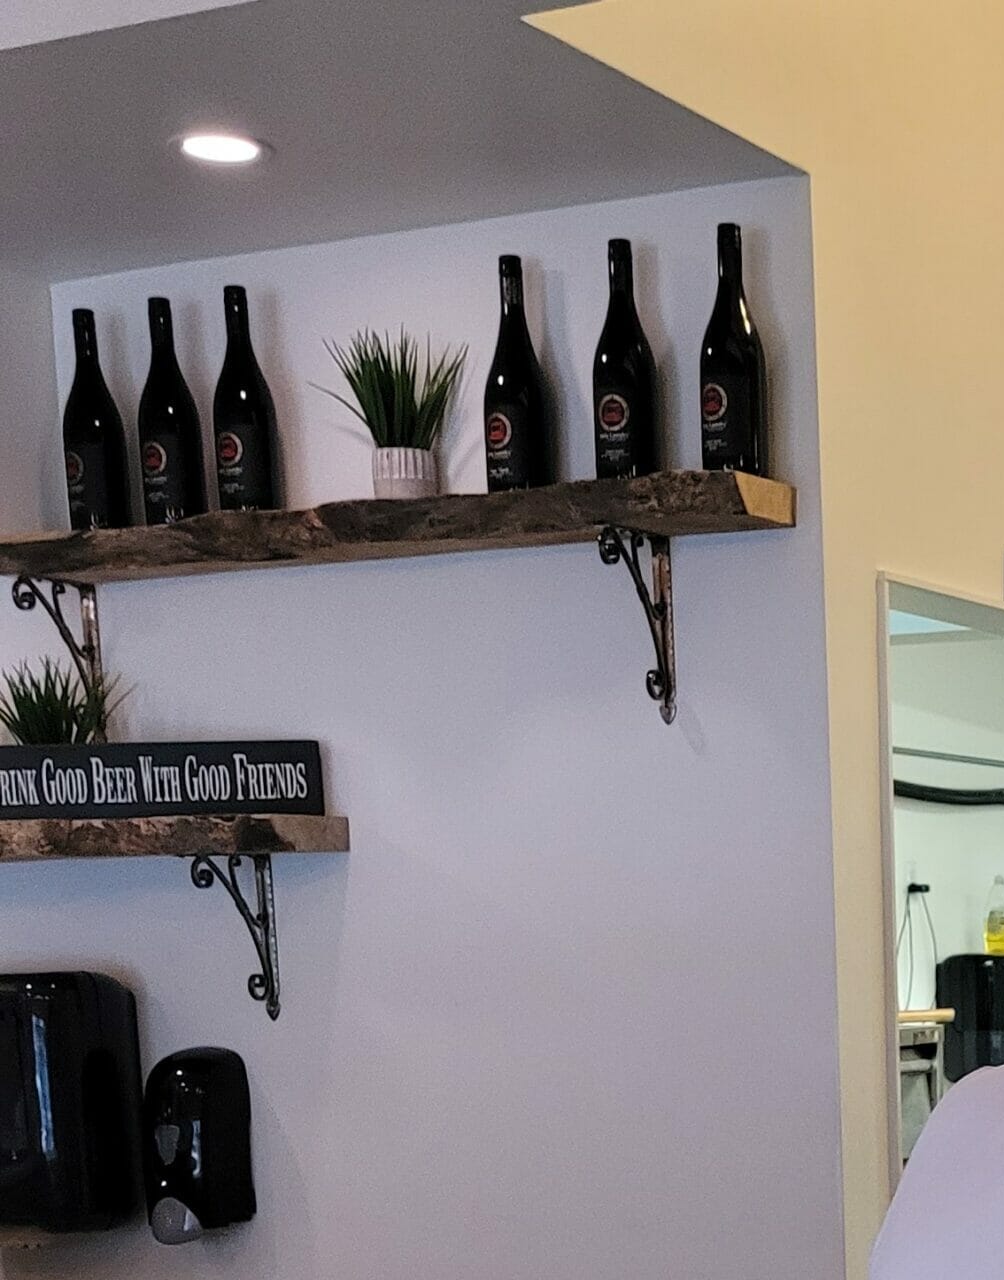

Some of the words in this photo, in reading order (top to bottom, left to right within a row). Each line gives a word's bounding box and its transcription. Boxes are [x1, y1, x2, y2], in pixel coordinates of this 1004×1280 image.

[42, 758, 88, 804] GOOD
[90, 757, 138, 803] BEER
[138, 756, 182, 802] WITH
[184, 755, 231, 800] GOOD
[232, 753, 308, 800] FRIENDS
